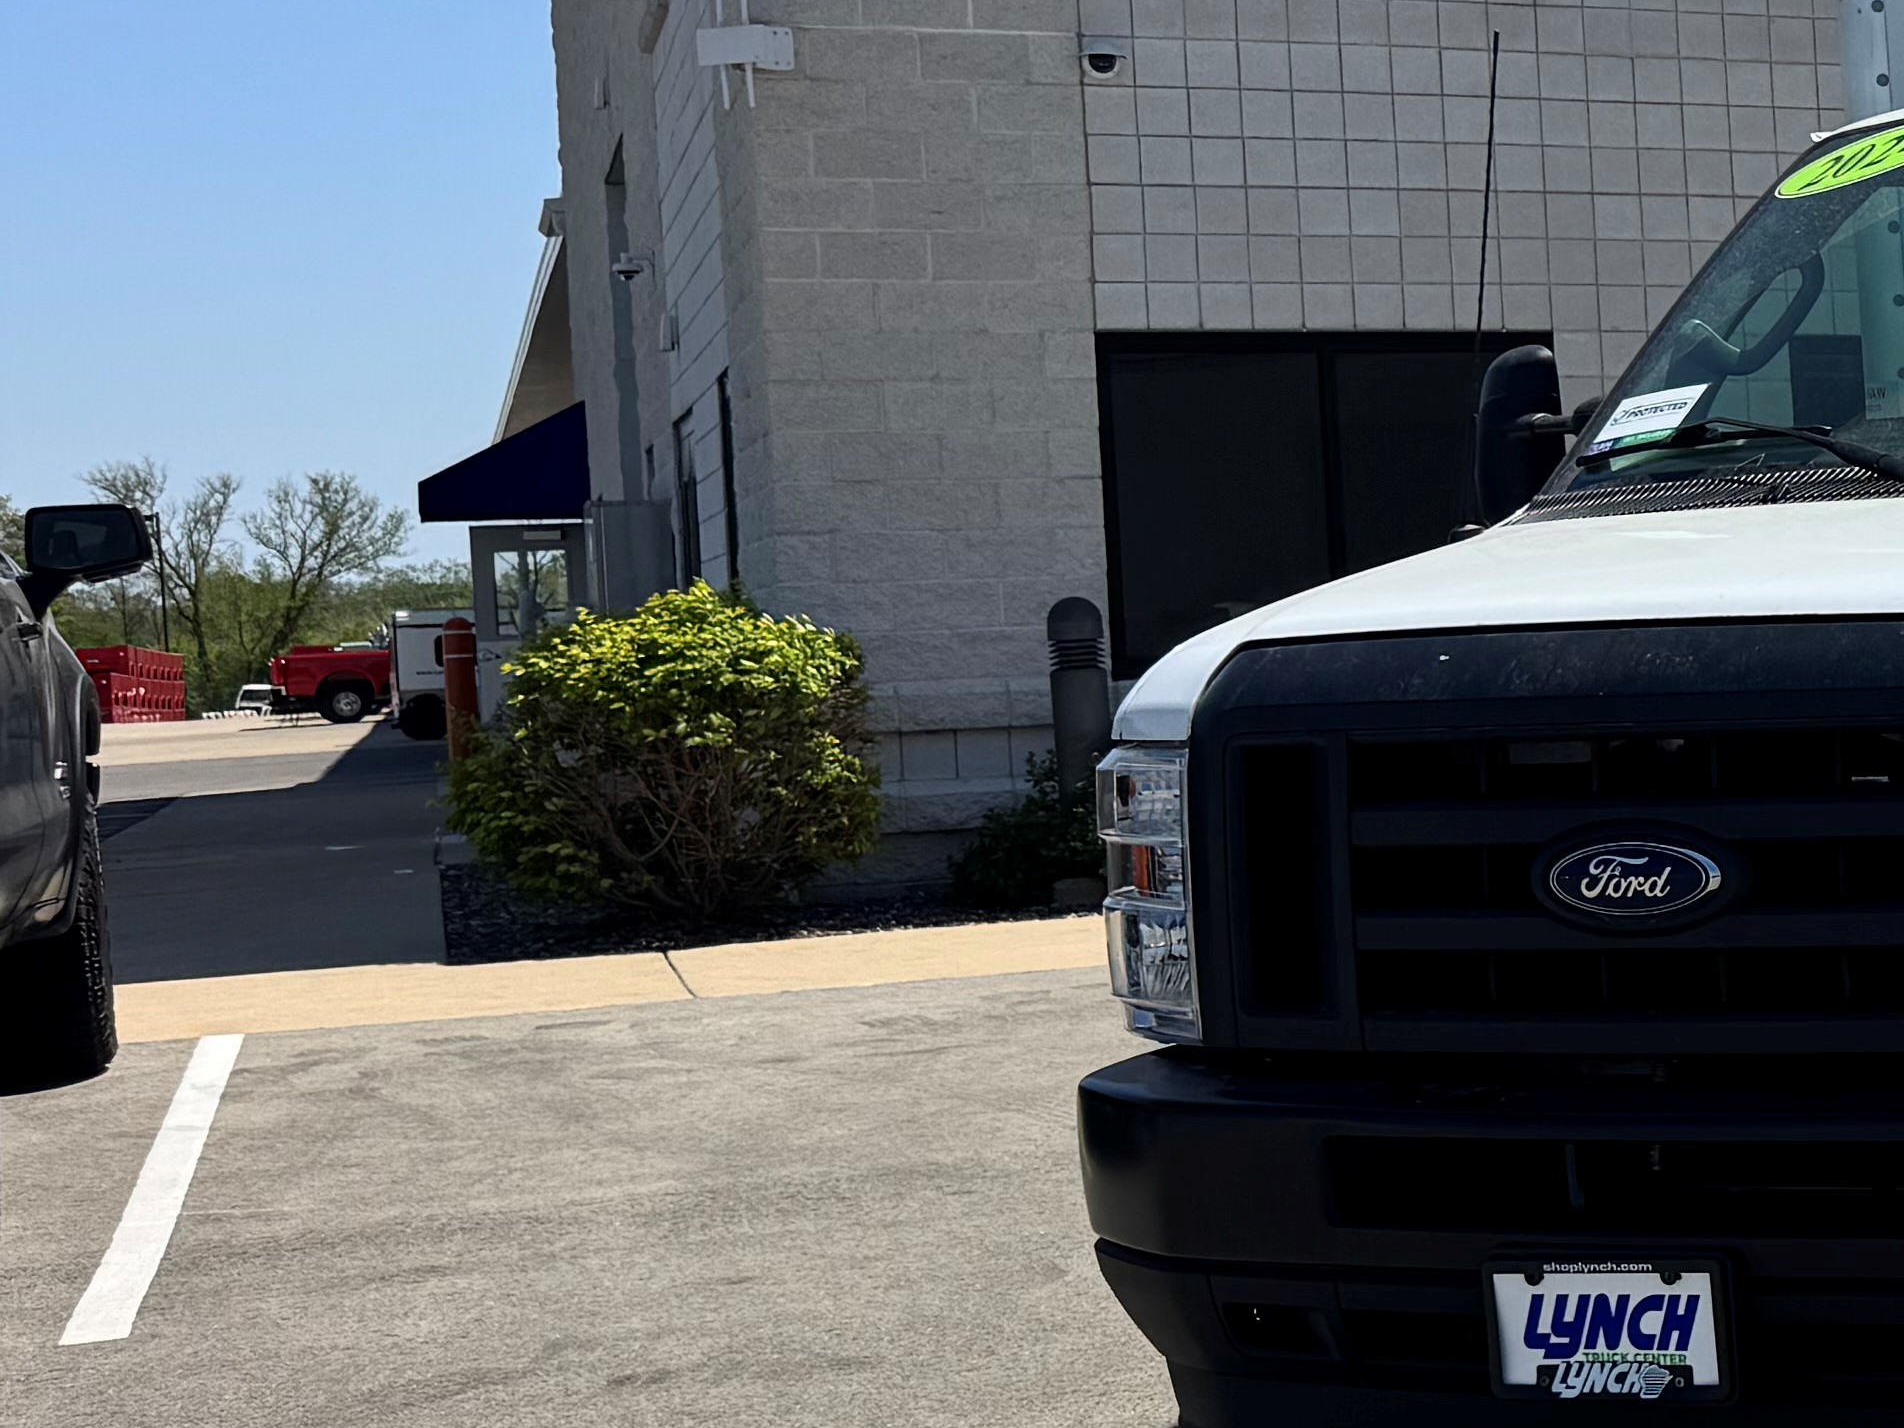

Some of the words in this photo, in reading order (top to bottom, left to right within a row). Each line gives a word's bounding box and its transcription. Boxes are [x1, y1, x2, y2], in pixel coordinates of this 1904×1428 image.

[1581, 856, 1672, 898] Ford
[1543, 1261, 1653, 1273] shoplynch.com
[1523, 1293, 1701, 1360] LYNCH
[1582, 1352, 1629, 1364] TRUCK
[1633, 1352, 1687, 1366] CENTER
[1551, 1362, 1648, 1398] LYNCH
